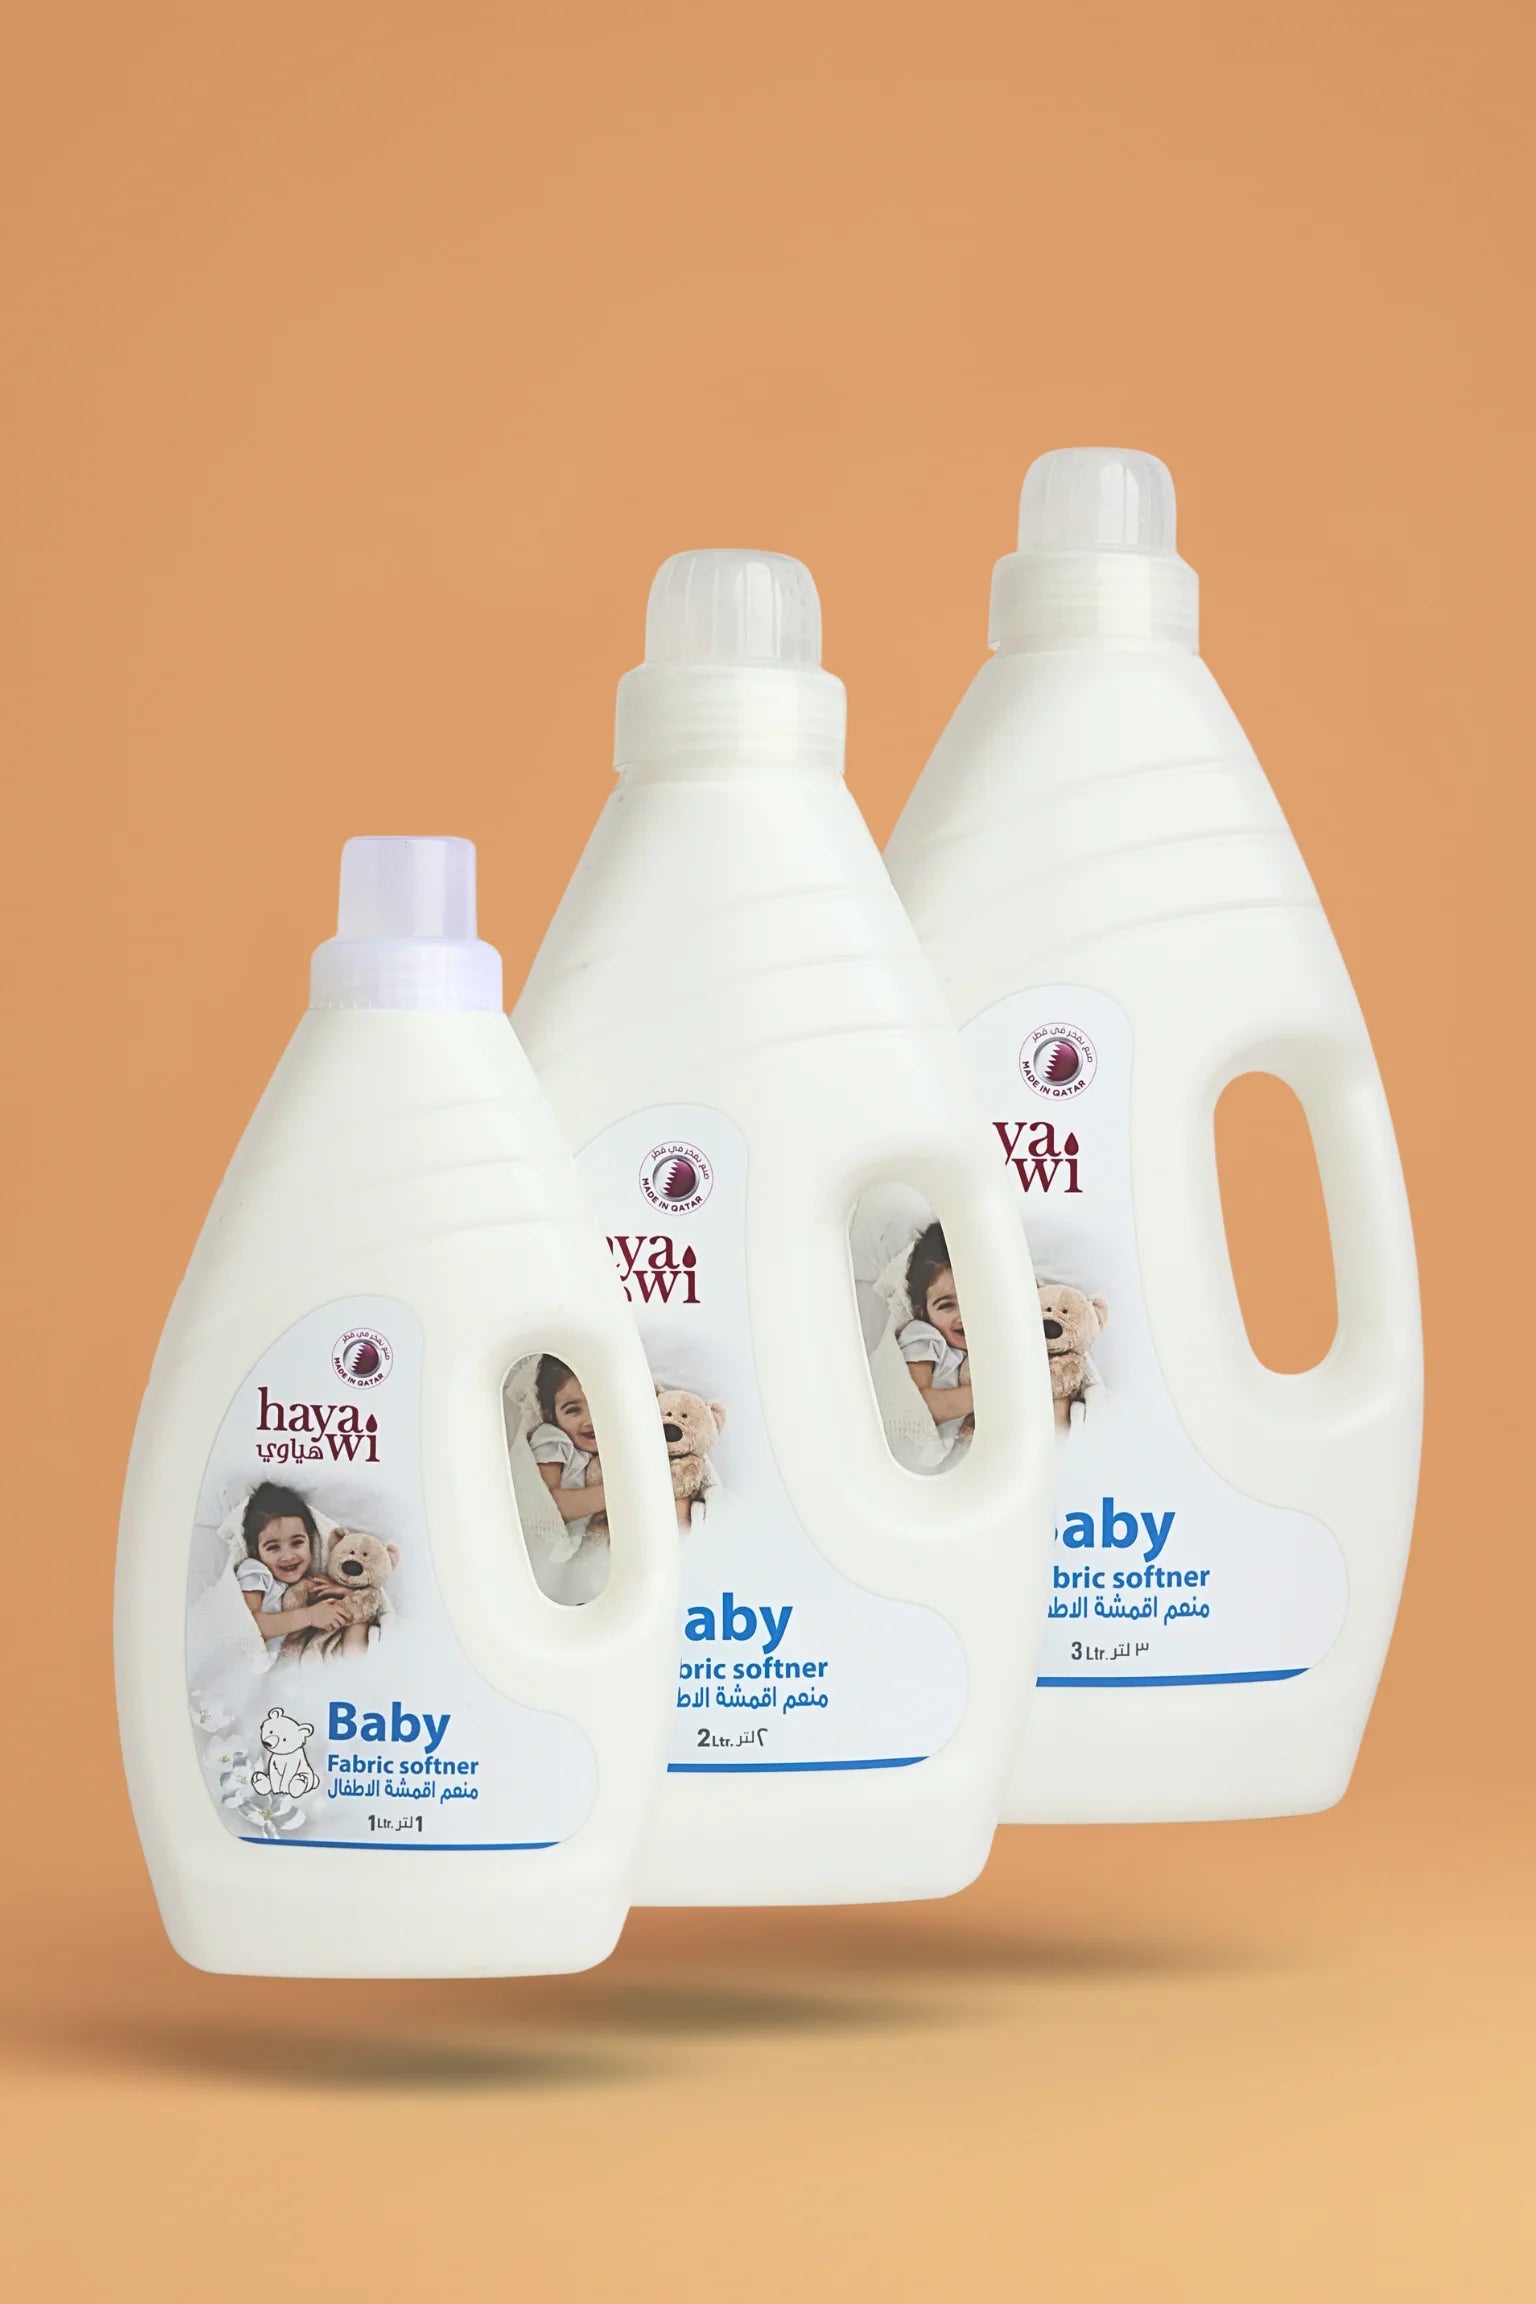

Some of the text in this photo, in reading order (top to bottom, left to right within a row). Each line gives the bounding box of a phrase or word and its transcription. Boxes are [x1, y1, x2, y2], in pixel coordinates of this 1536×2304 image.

[1022, 1061, 1086, 1096] MADE IN QATAR
[992, 1121, 1061, 1166] ya
[642, 1178, 703, 1212] MADE IN QATAR
[606, 1235, 680, 1282] ya
[334, 1357, 348, 1379] MADE
[358, 1373, 384, 1386] QATAR
[256, 1438, 324, 1464] هياوي
[1055, 1497, 1176, 1563] aby
[1053, 1565, 1210, 1589] bric softner
[684, 1592, 793, 1655] aby
[1048, 1593, 1210, 1626] منعم اقمشة الاط
[1110, 1643, 1130, 1660] لتر
[679, 1656, 828, 1679] bric softner
[677, 1684, 828, 1714] منعم اقمشة الاط
[328, 1701, 451, 1755] Baby
[328, 1754, 479, 1775] Fabric softner
[328, 1778, 479, 1804] منعم اقمشة الاطفال
